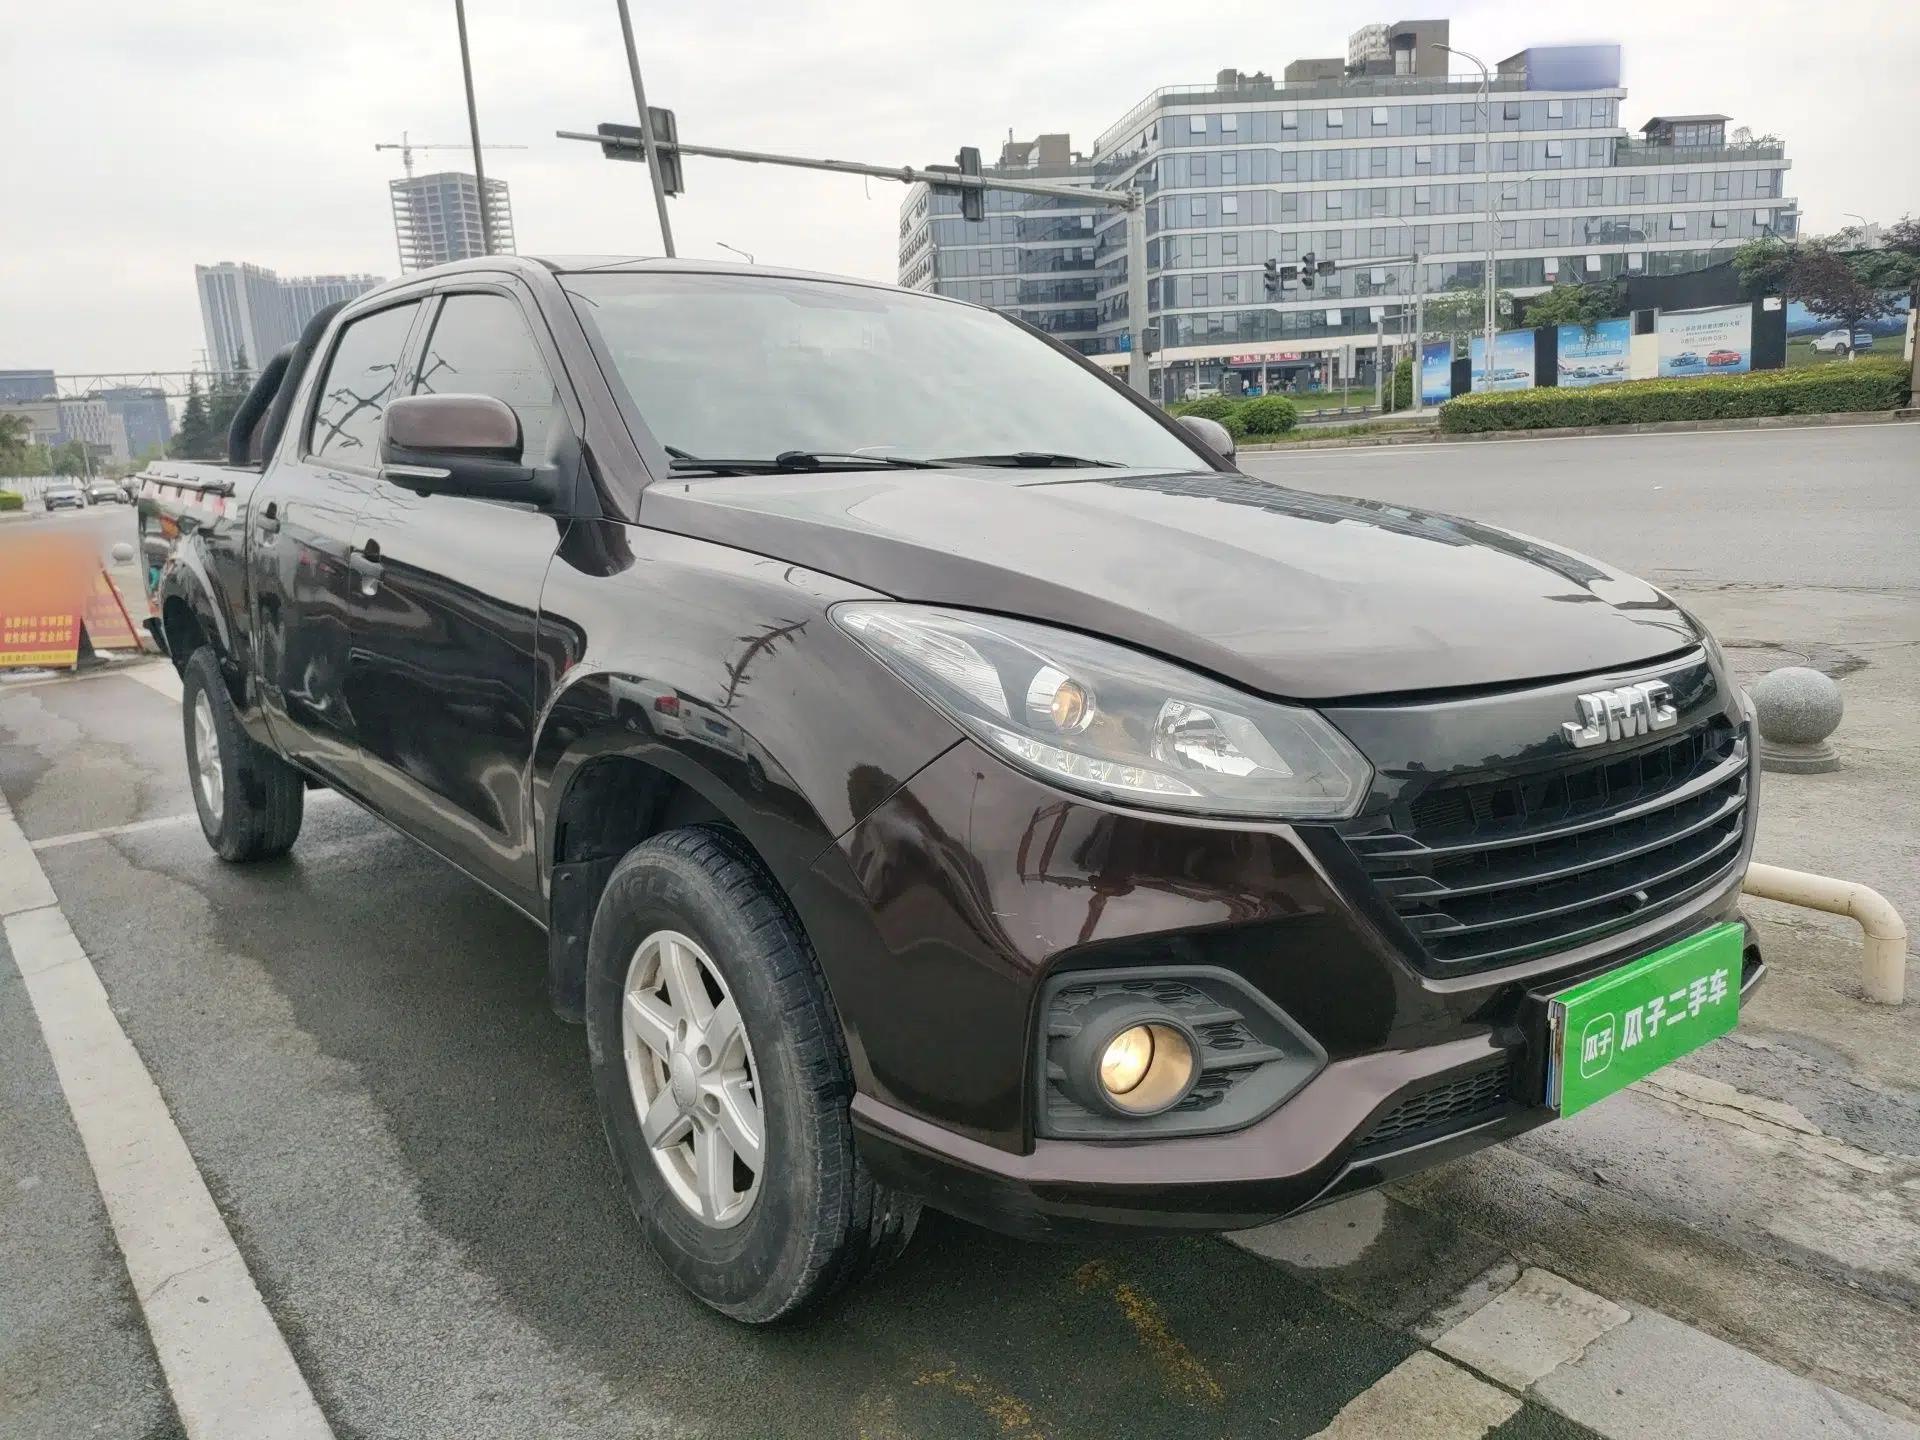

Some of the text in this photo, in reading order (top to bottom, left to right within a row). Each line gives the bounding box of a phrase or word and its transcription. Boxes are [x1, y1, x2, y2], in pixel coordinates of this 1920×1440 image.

[1561, 680, 1678, 748] JMC
[1620, 968, 1729, 1052] 瓜子二手车
[1584, 1028, 1613, 1063] 瓜子
